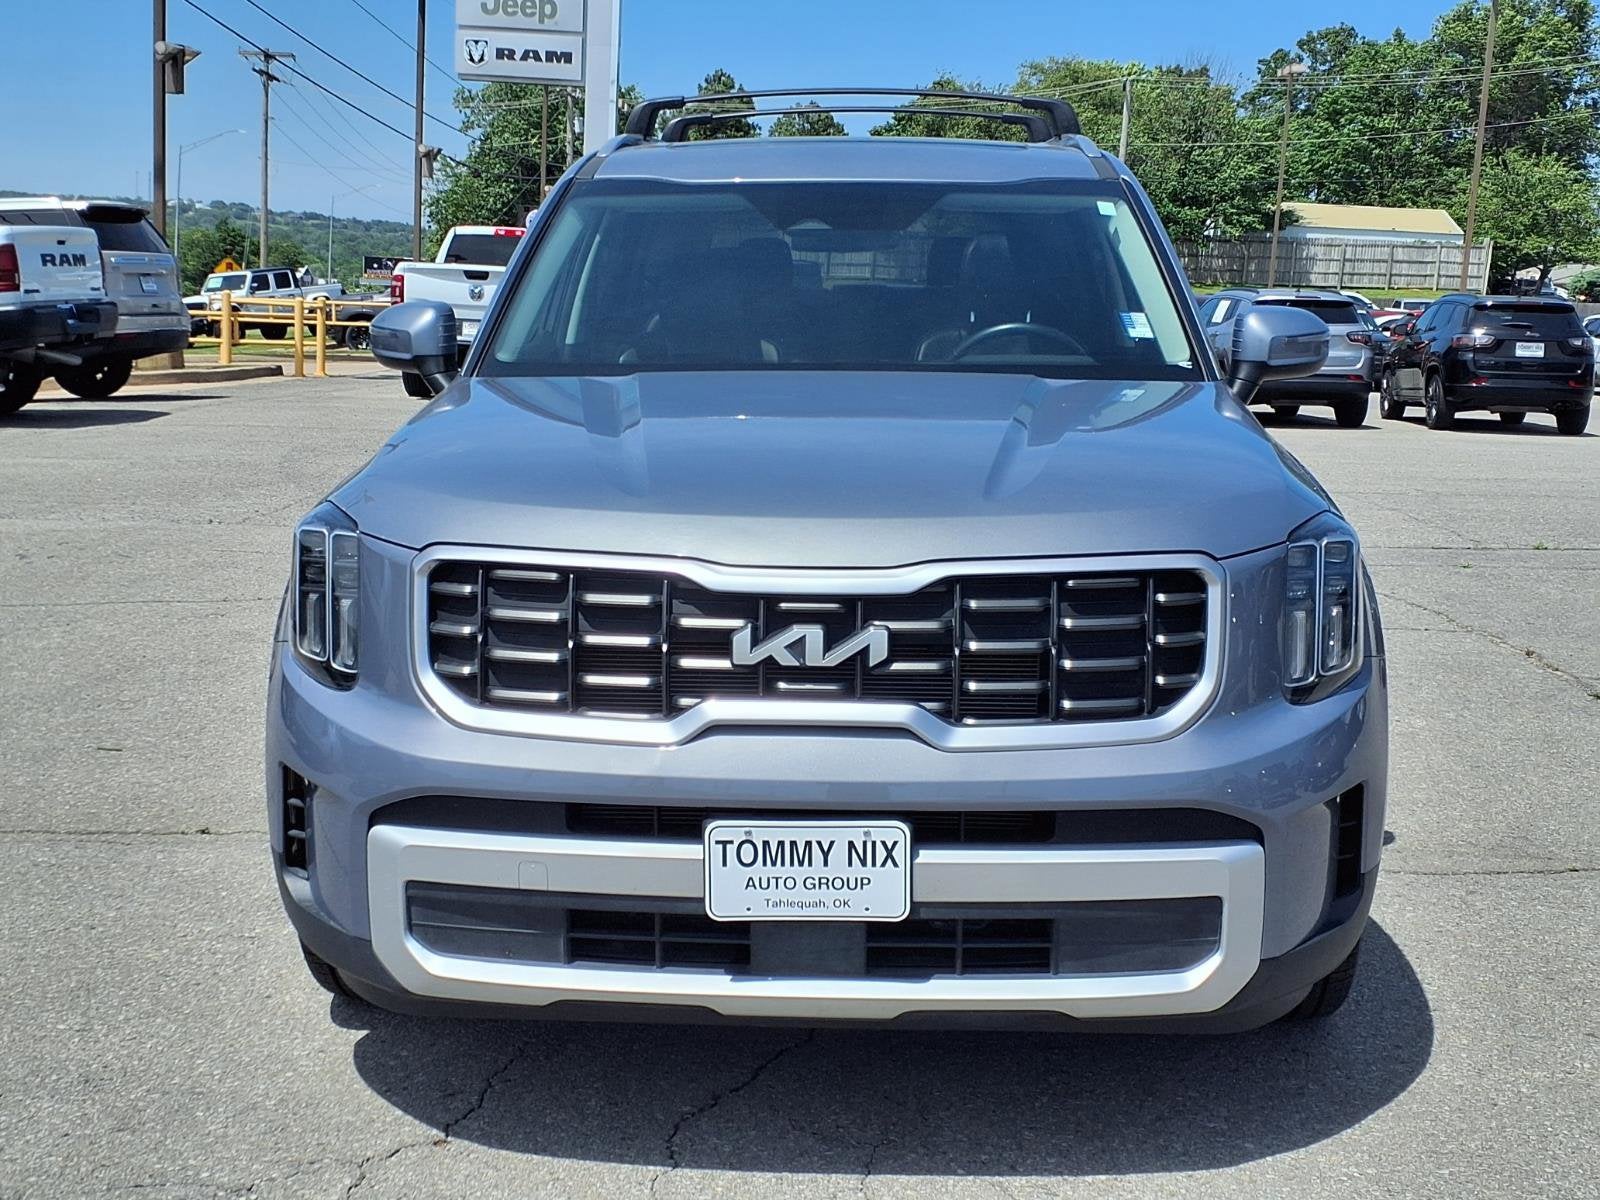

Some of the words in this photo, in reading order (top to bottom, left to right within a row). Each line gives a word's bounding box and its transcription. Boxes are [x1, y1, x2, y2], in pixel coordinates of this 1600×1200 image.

[480, 0, 558, 24] Jeep
[495, 47, 573, 64] RAM
[40, 253, 87, 267] RAM
[732, 624, 888, 667] KIA
[715, 840, 836, 868] TOMMY
[847, 840, 900, 868] NIX
[744, 876, 797, 891] AUTO
[803, 876, 871, 891] GROUP
[764, 898, 829, 911] Tahlequah,
[833, 898, 851, 909] OK
